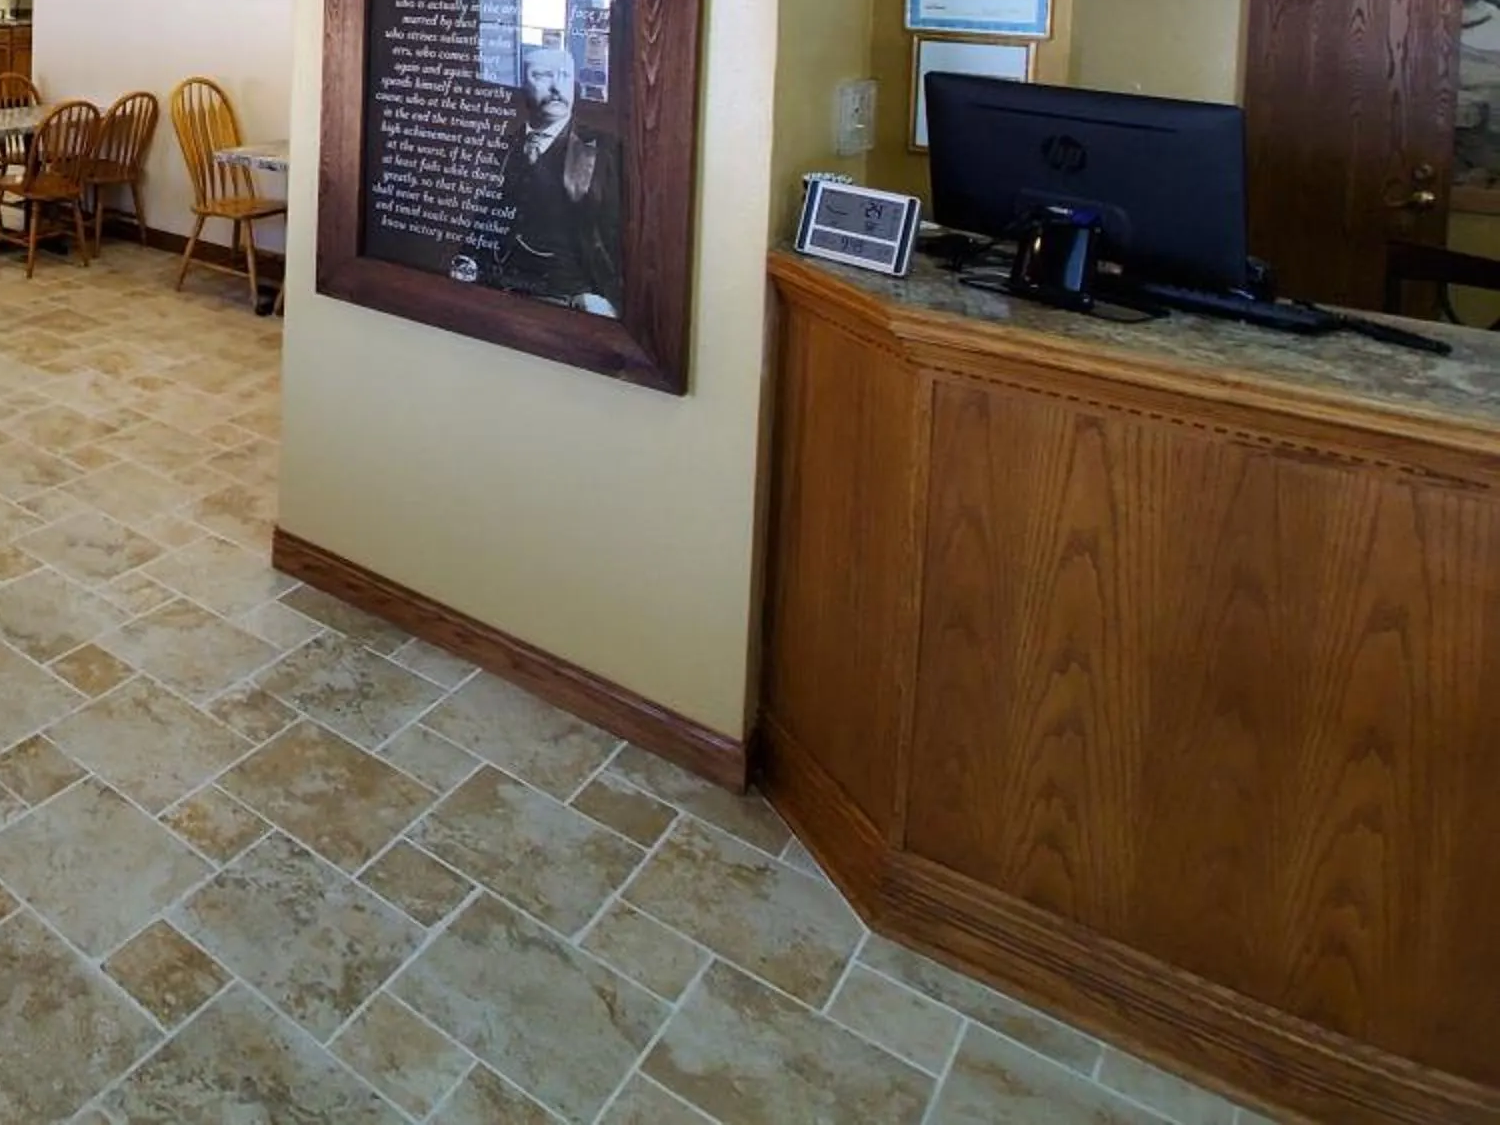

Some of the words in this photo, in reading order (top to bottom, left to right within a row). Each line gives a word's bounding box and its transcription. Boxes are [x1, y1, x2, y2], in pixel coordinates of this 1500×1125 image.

[385, 27, 405, 40] who
[415, 44, 436, 58] who
[422, 63, 443, 75] and
[414, 76, 453, 97] himself
[473, 86, 514, 104] worthy
[405, 92, 426, 106] who
[441, 96, 457, 110] the
[459, 98, 482, 113] best
[483, 101, 517, 117] knows
[381, 119, 401, 137] high
[463, 134, 485, 147] and
[485, 136, 509, 151] who
[395, 106, 410, 120] the
[411, 110, 431, 123] end
[432, 112, 448, 125] the
[450, 117, 491, 135] triumph
[493, 119, 509, 136] of
[399, 138, 415, 153] the
[394, 155, 418, 168] least
[418, 159, 442, 173] fails
[443, 162, 470, 178] while
[471, 168, 505, 188] daring
[371, 182, 395, 196] shall
[395, 189, 421, 202] never
[437, 194, 460, 208] with
[461, 198, 489, 215] those
[491, 206, 517, 221] cold
[435, 177, 457, 192] that
[457, 180, 473, 195] his
[473, 185, 504, 201] place
[375, 199, 394, 213] and
[395, 203, 422, 217] timid
[450, 213, 472, 229] who
[473, 219, 511, 236] neither
[380, 213, 407, 230] know
[408, 220, 444, 243] victory
[444, 231, 464, 243] nor
